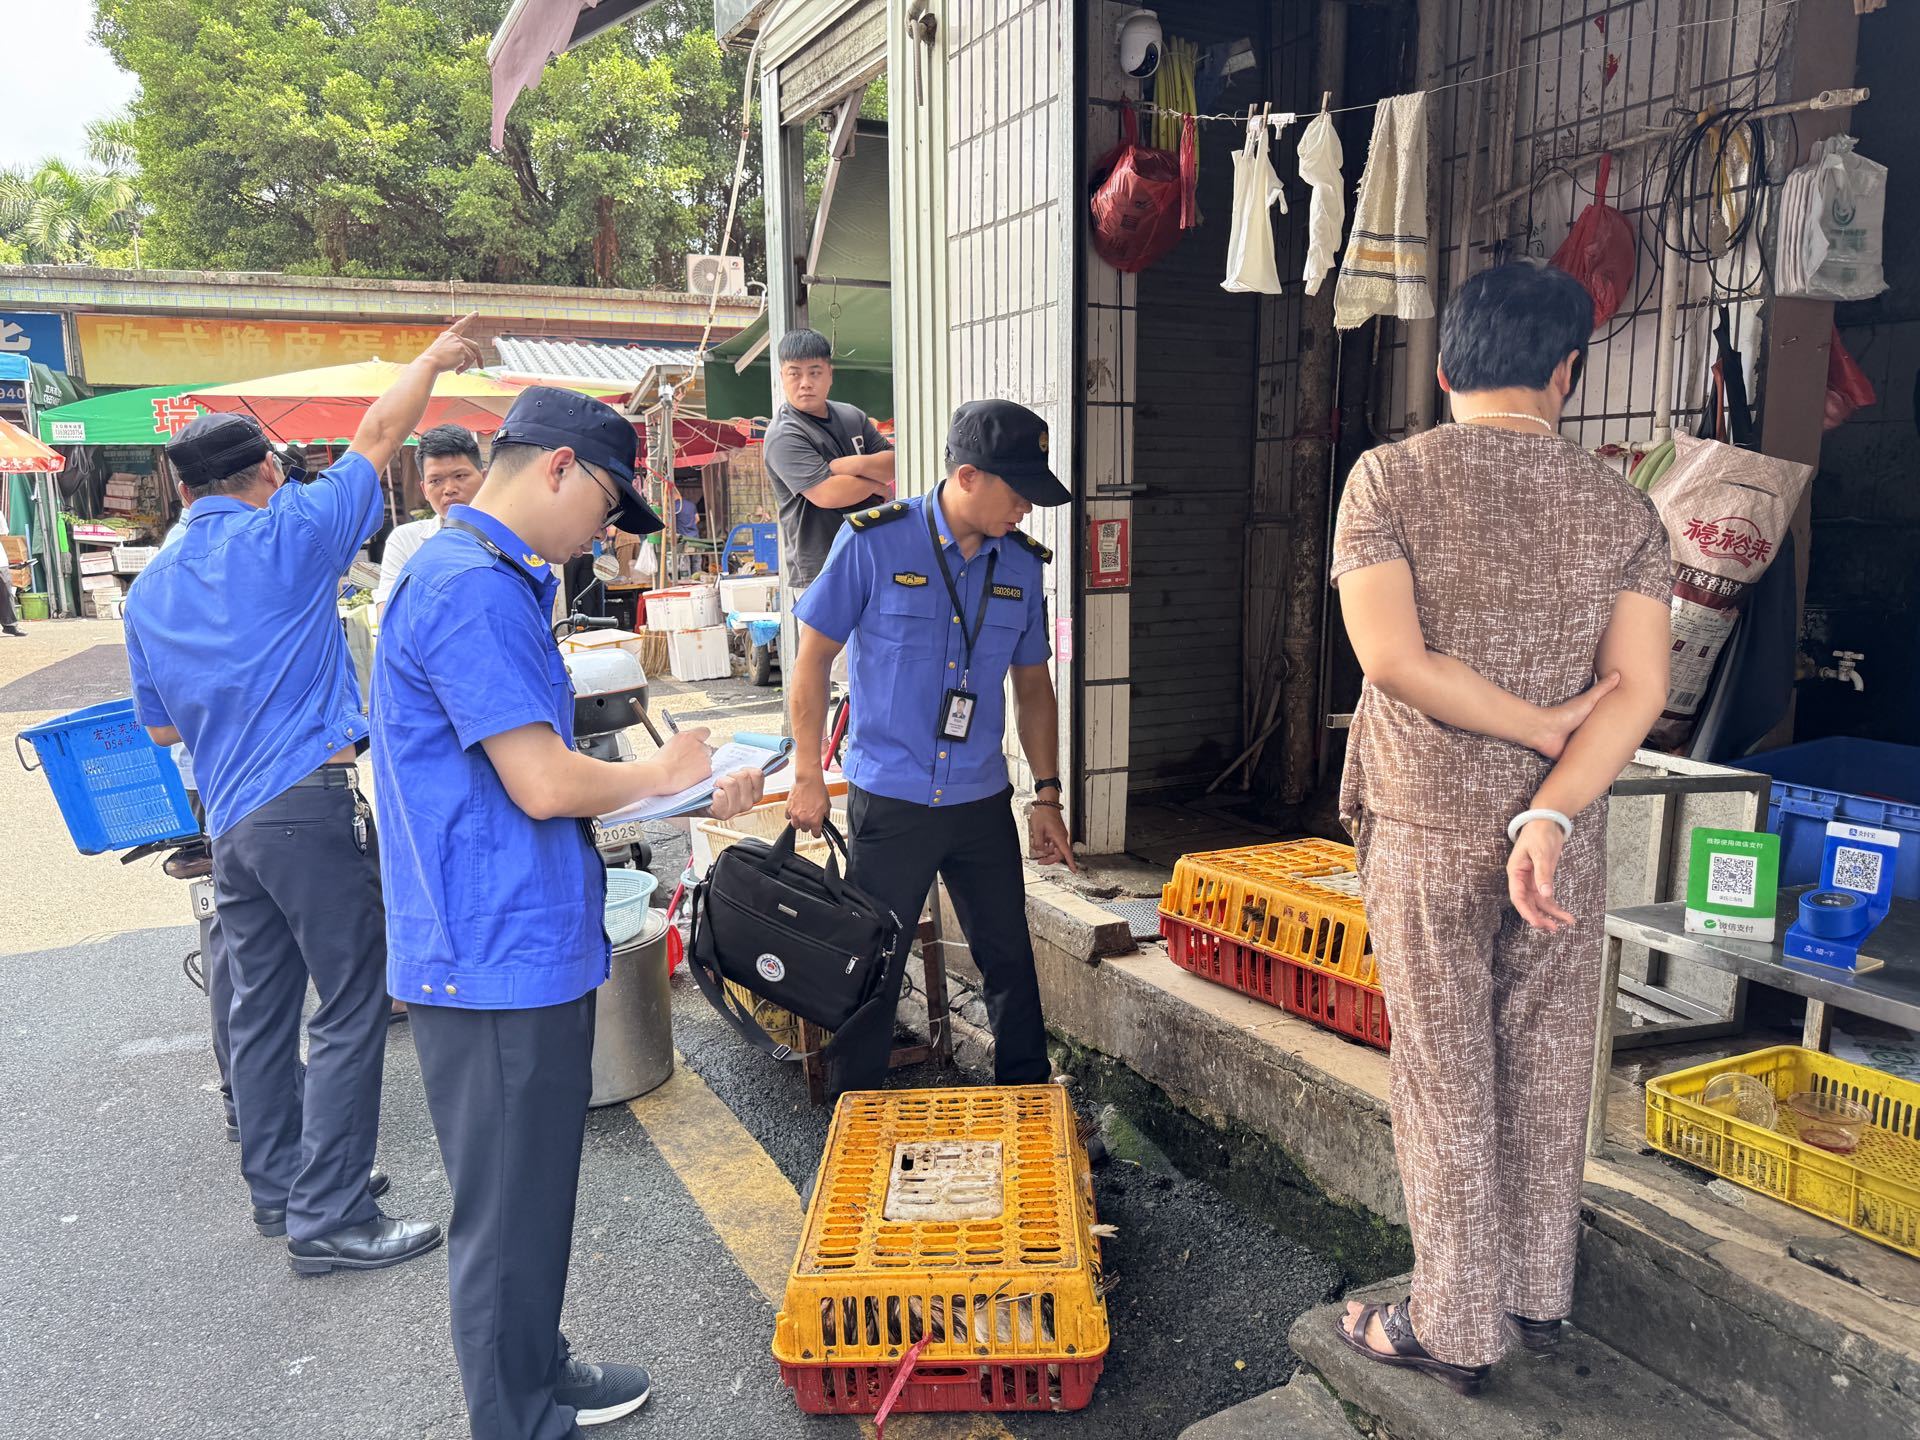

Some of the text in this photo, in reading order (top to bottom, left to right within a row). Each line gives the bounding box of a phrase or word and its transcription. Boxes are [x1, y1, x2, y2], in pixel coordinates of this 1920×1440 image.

[1706, 837, 1764, 850] 推荐使用微信支付
[1719, 921, 1754, 934] 微信支付
